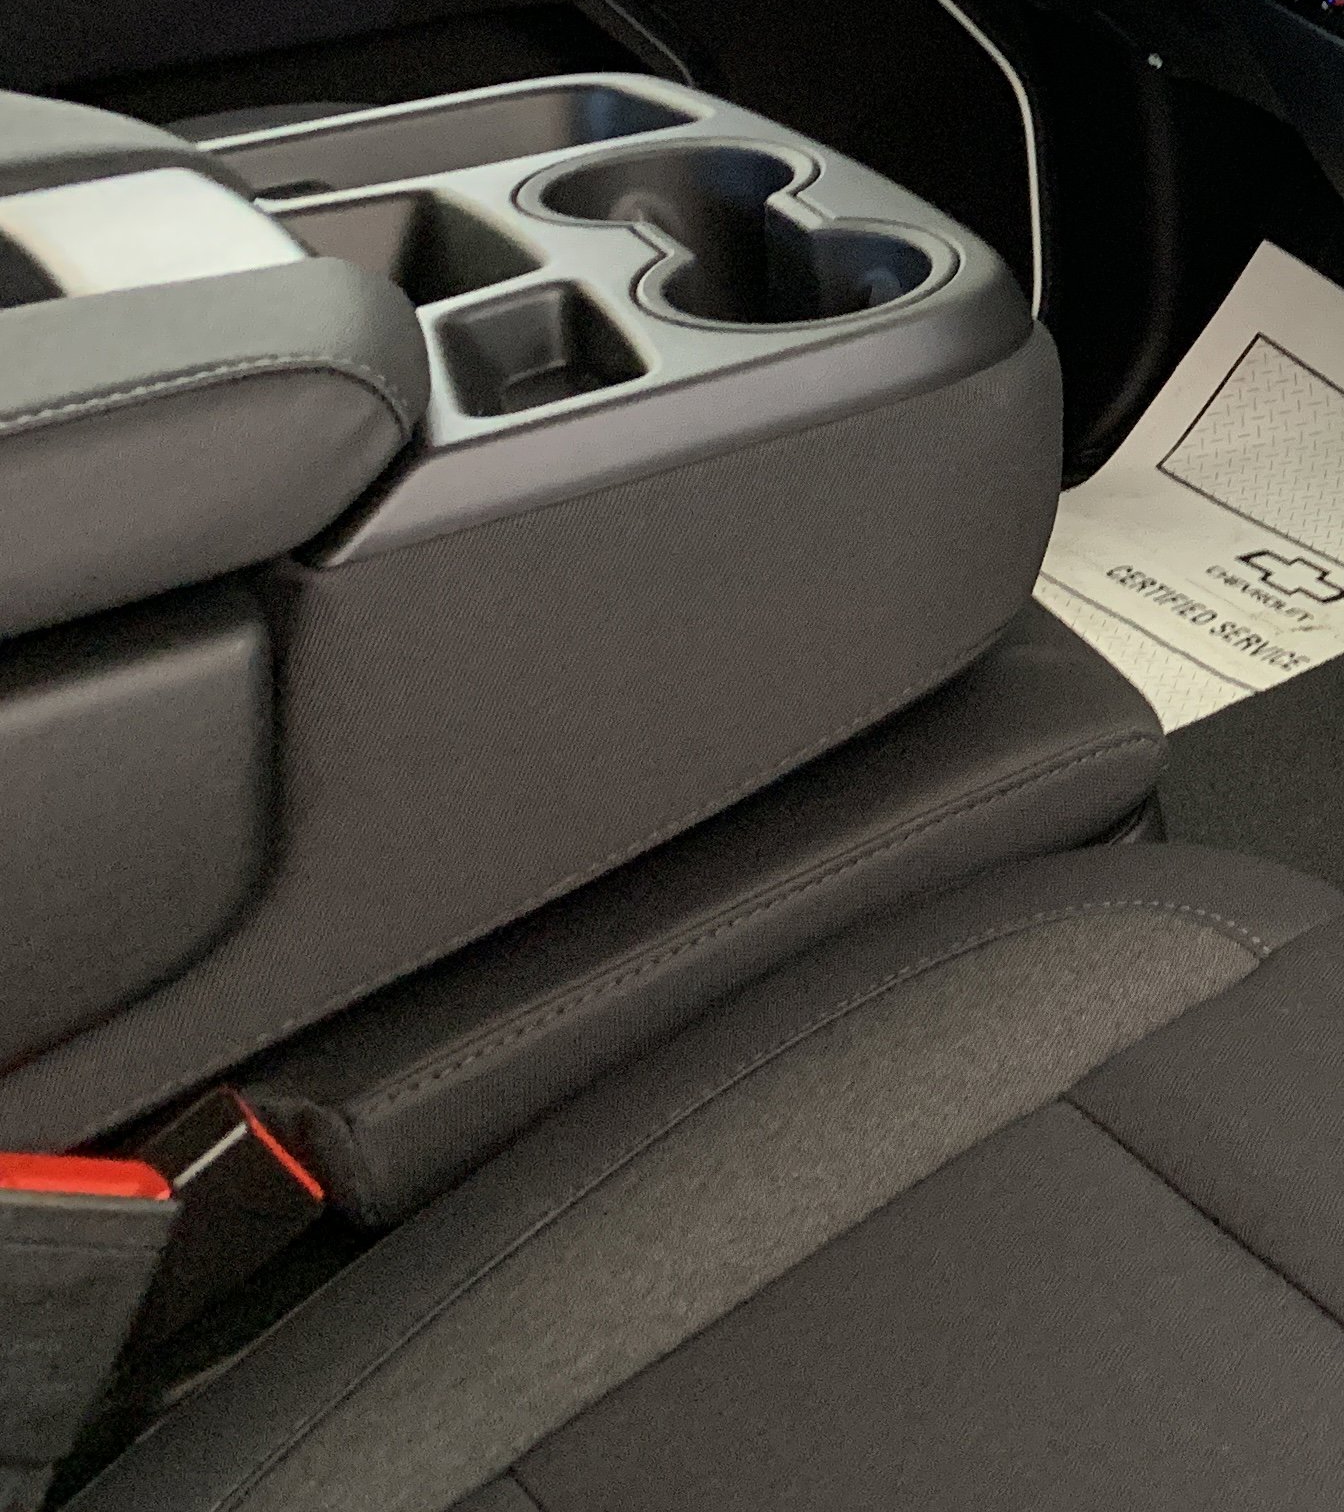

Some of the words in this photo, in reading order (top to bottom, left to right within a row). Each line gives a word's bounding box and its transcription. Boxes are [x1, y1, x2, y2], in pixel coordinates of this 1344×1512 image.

[1106, 564, 1216, 627] CERTIFIED
[1210, 621, 1311, 672] SERVICE
[1205, 565, 1314, 622] CHEVROLET
